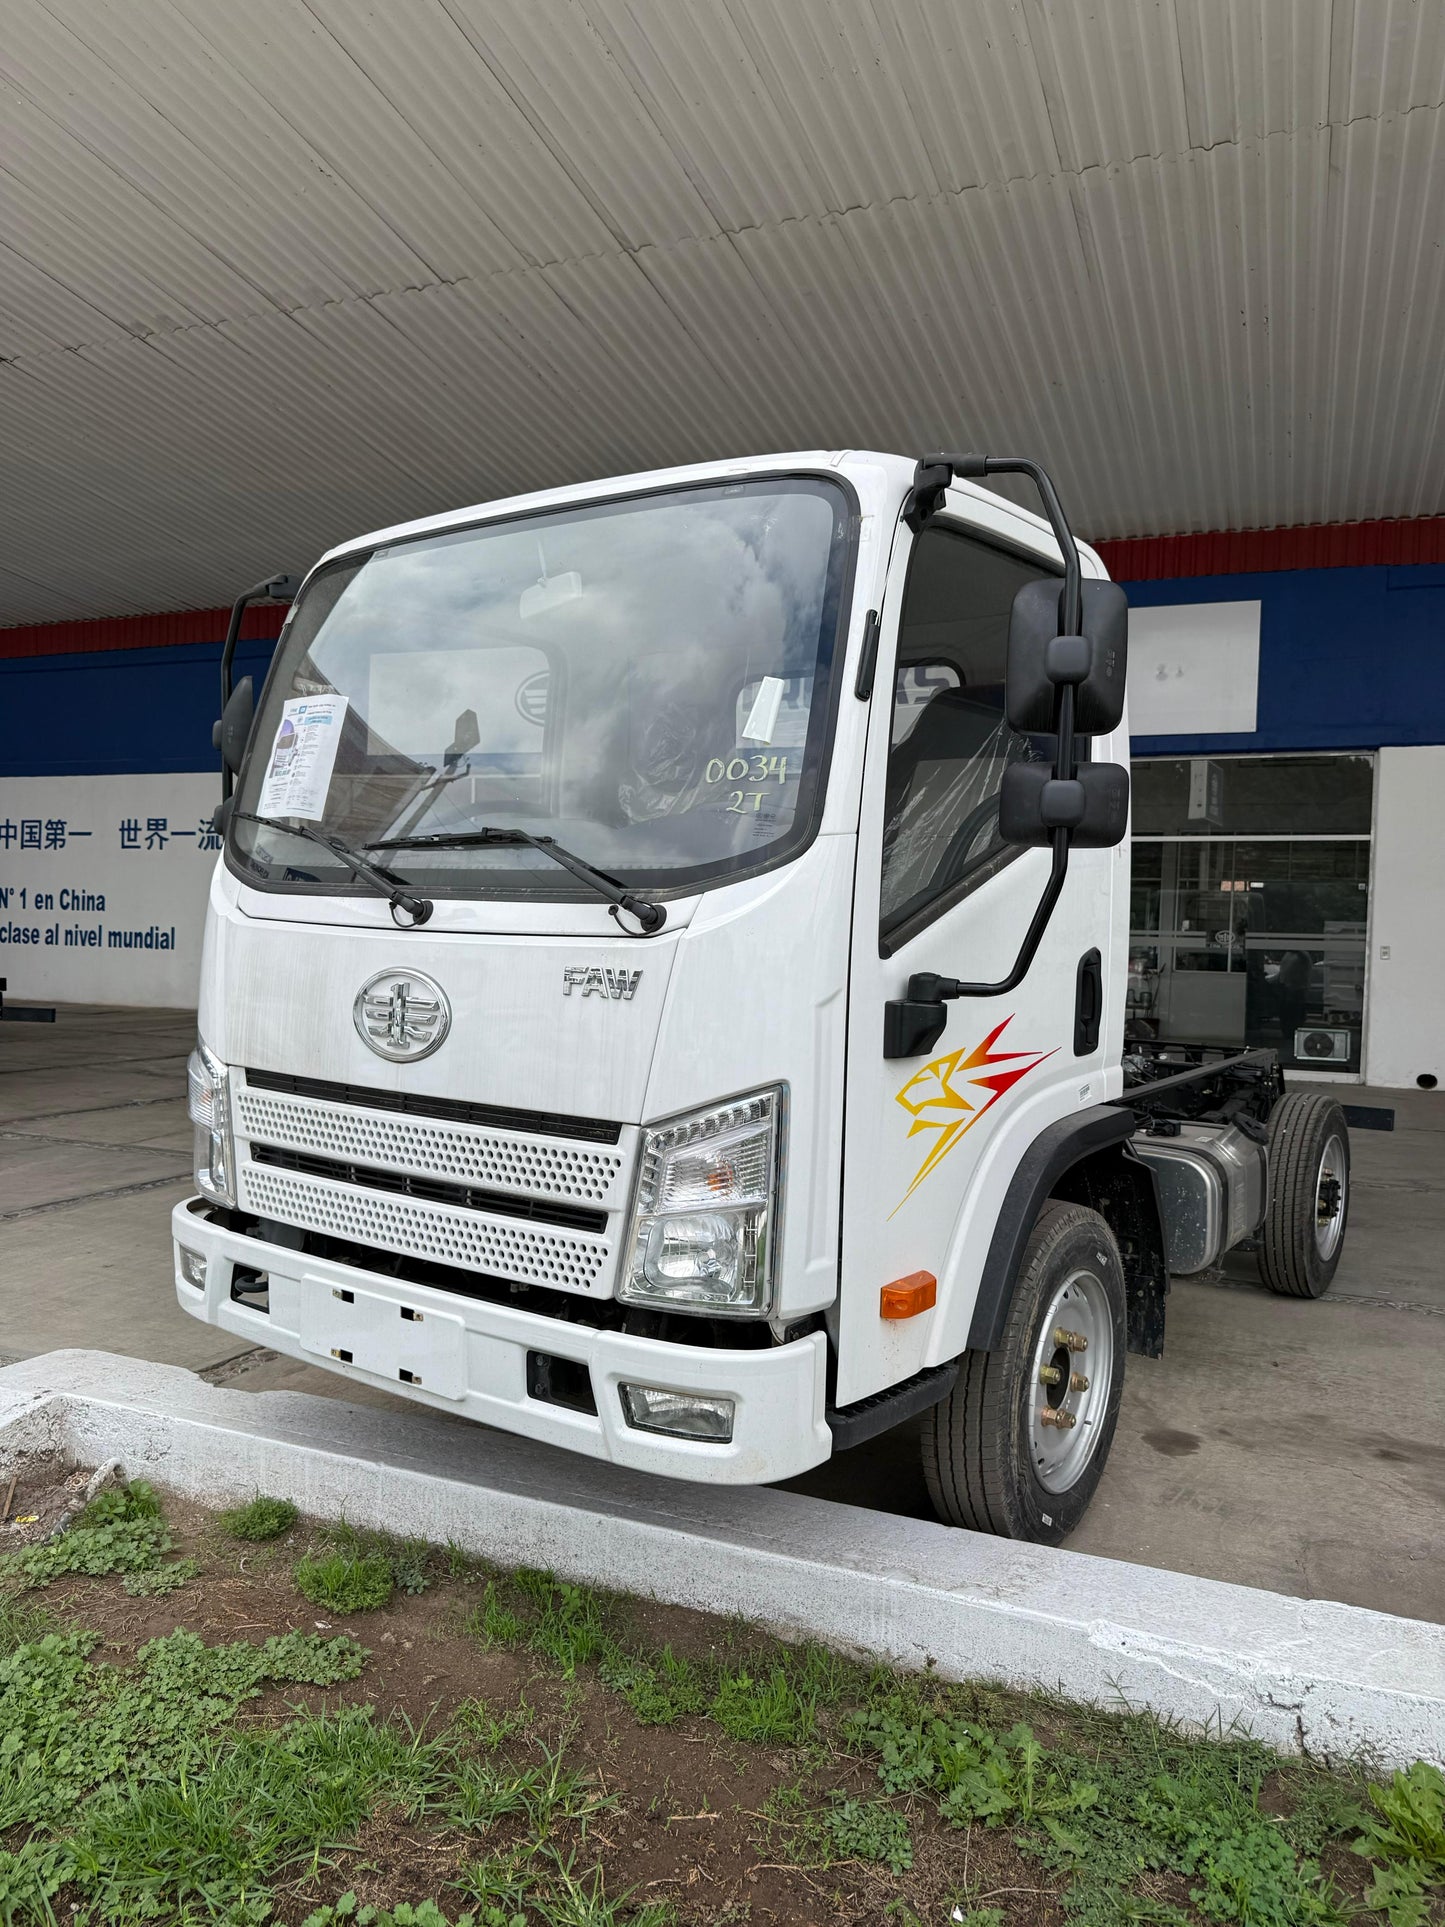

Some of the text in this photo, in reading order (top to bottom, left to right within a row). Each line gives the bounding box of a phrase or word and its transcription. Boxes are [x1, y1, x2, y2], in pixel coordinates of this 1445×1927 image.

[705, 754, 788, 785] 0034
[725, 790, 772, 815] 2T
[0, 818, 223, 851] 中国第一 世界一流
[19, 887, 27, 909] 1
[34, 893, 54, 910] en
[59, 888, 106, 911] China
[0, 921, 176, 950] clase al nivel mundial
[562, 966, 644, 1000] FAW
